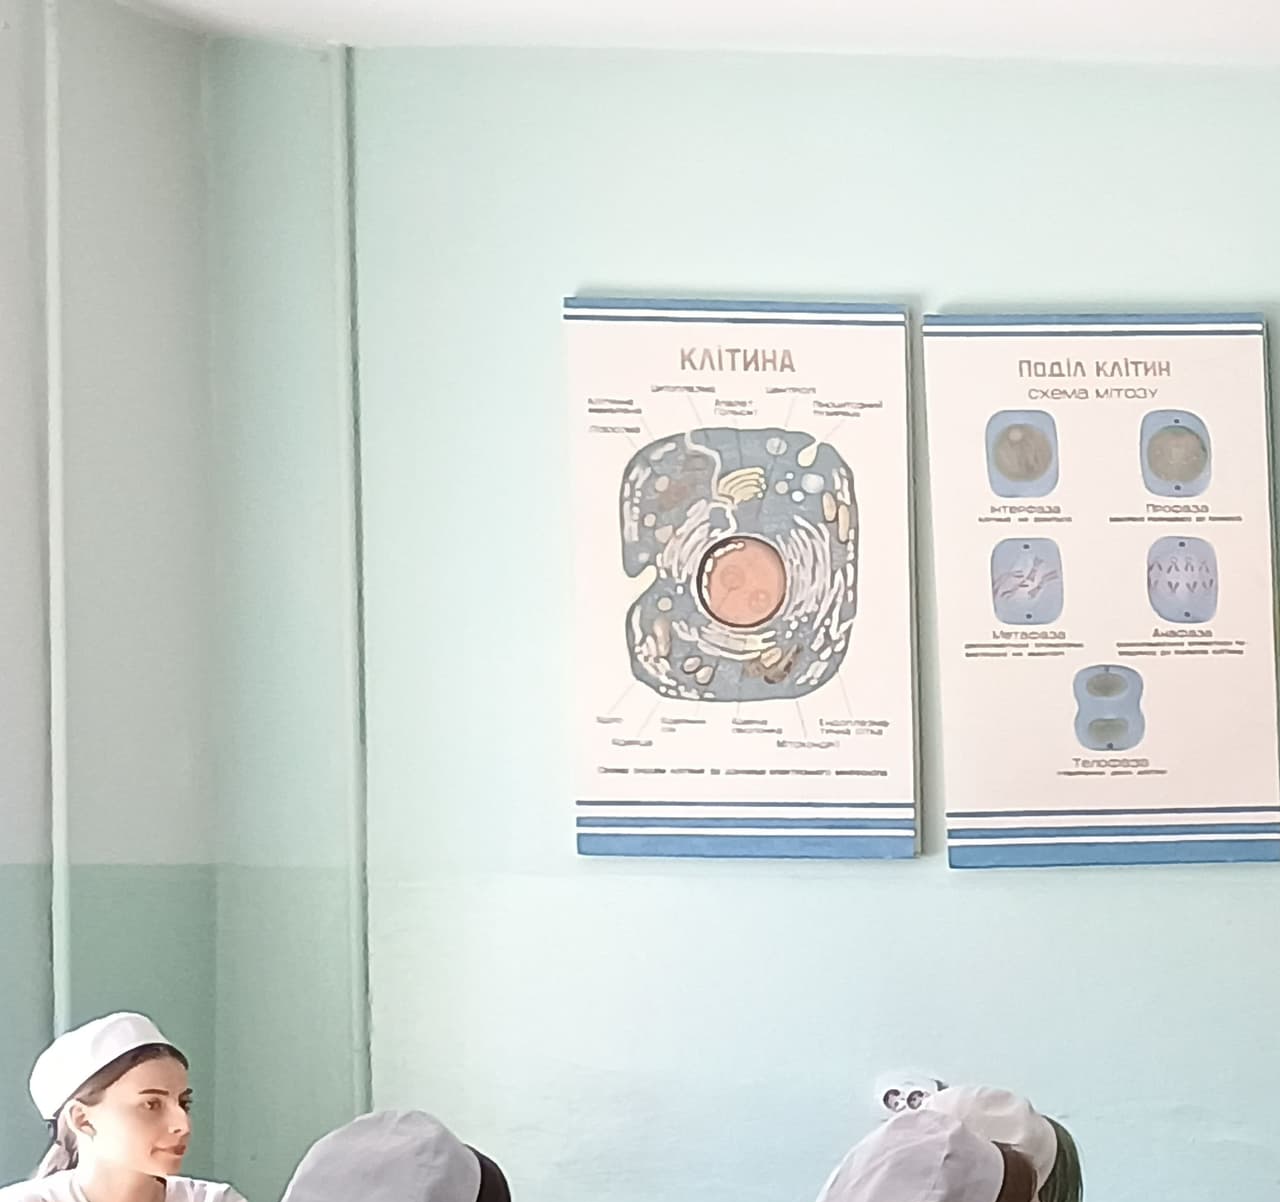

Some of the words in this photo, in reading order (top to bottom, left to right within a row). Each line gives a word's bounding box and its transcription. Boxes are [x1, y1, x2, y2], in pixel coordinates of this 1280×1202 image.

[680, 345, 796, 373] КЛІТИНА
[1018, 358, 1087, 379] ПОДІЛ
[1095, 357, 1172, 378] КЛІТИН
